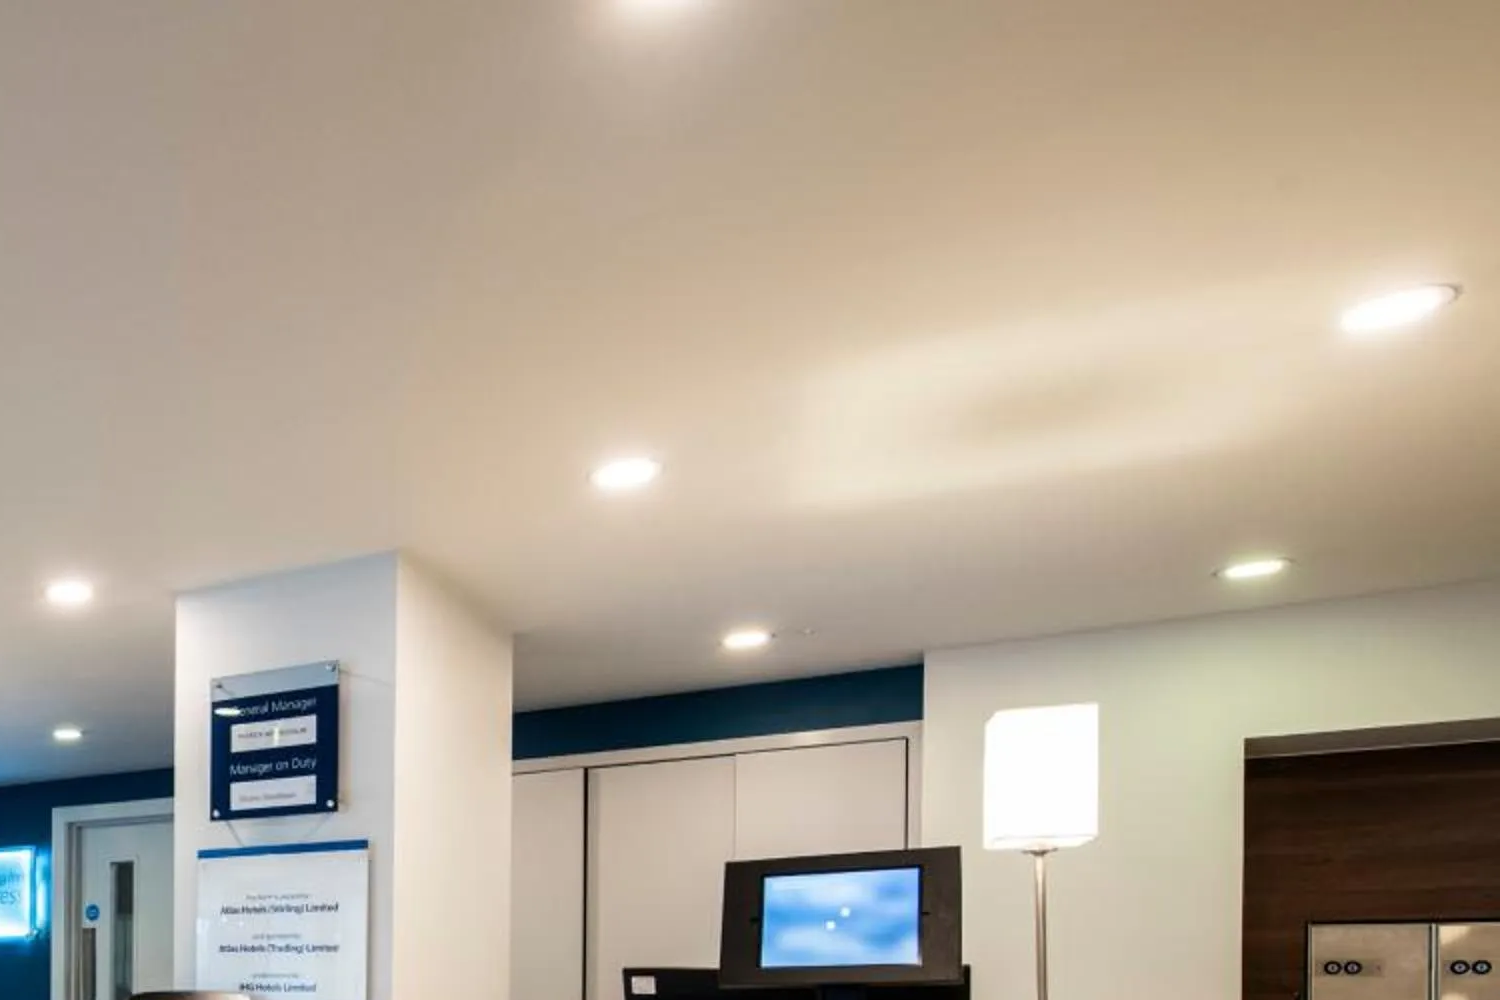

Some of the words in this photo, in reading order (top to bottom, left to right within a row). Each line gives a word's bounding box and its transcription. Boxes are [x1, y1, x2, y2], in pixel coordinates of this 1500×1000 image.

[231, 701, 268, 717] eneral
[271, 698, 317, 712] Manager
[229, 762, 273, 776] Manager
[275, 760, 289, 771] on
[291, 757, 317, 770] Duty
[306, 902, 339, 912] Limited
[255, 982, 282, 992] Hotels
[284, 982, 316, 993] Limited
